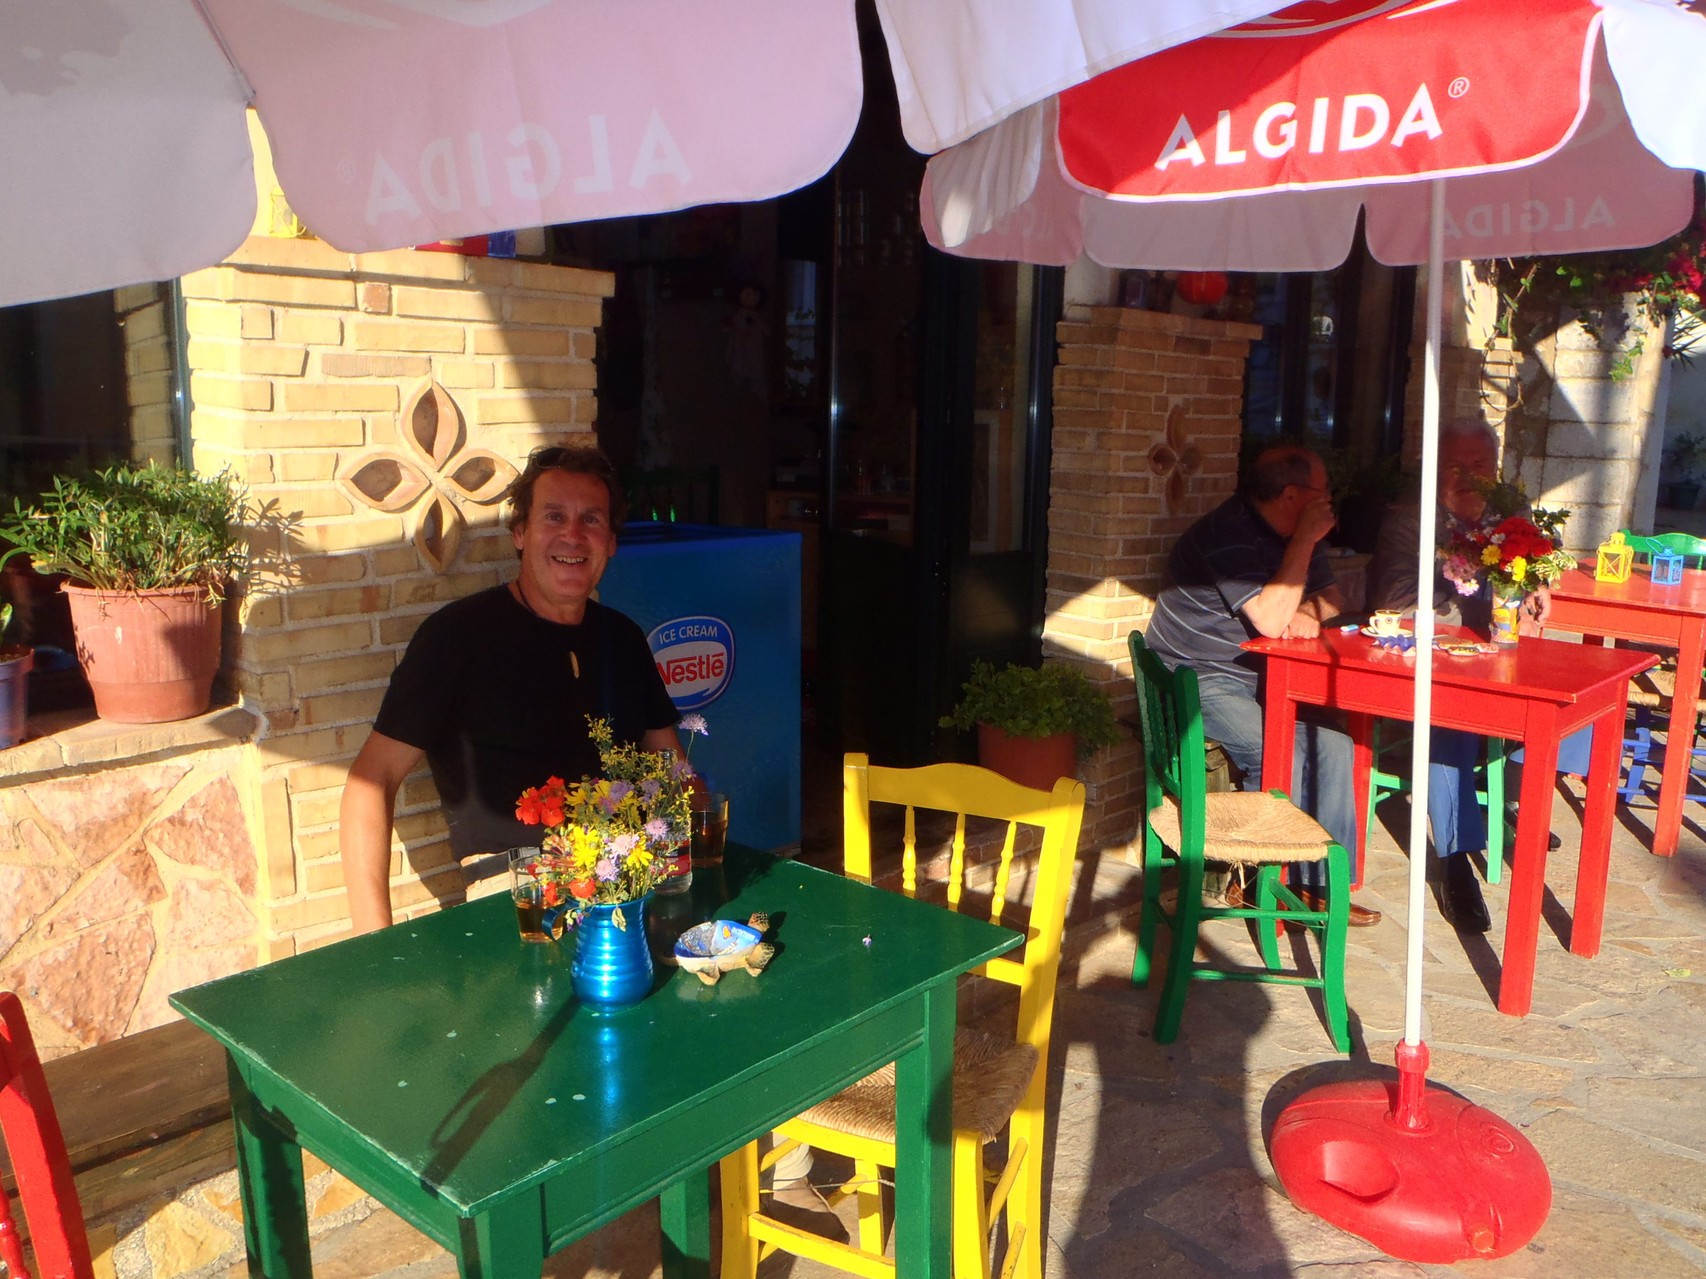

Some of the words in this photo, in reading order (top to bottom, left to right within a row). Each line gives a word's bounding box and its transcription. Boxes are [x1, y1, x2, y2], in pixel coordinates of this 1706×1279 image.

[1154, 82, 1443, 171] ALGIDA
[660, 629, 676, 645] ICE
[679, 625, 717, 638] CREAM
